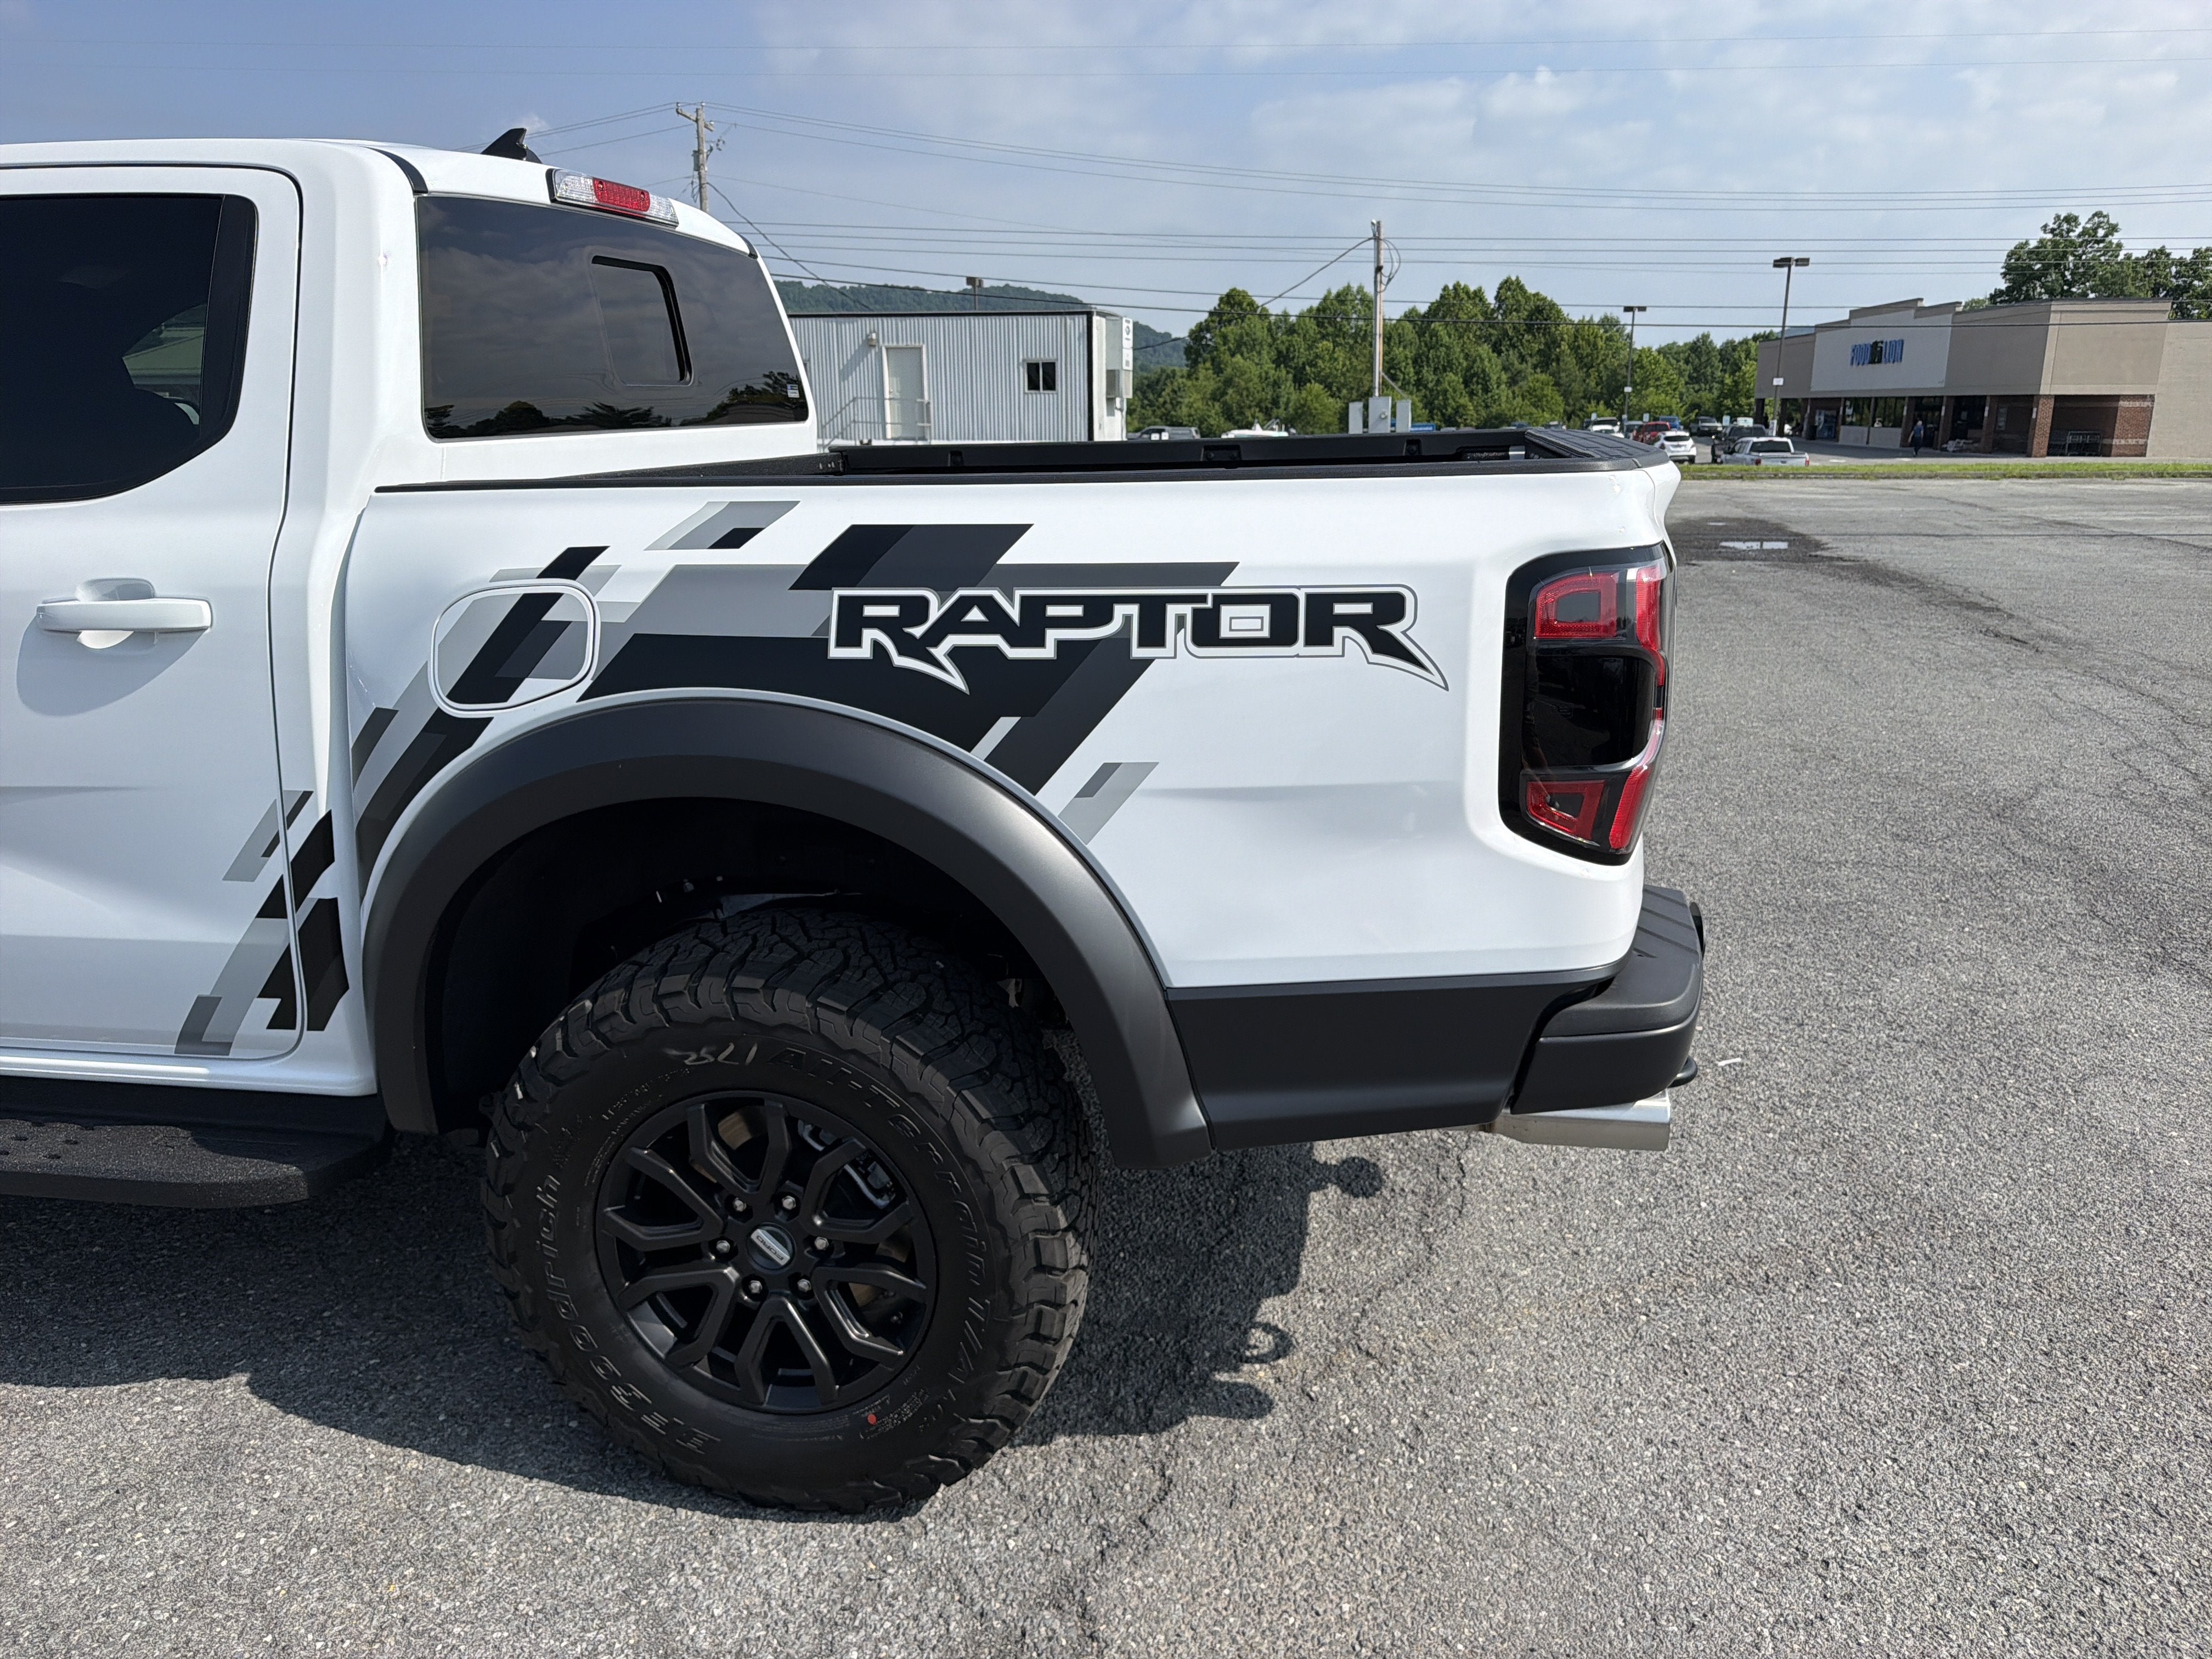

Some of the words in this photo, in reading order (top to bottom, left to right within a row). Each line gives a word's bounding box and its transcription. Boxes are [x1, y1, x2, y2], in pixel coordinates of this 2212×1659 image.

[1850, 343, 1873, 366] FOOD
[1882, 338, 1904, 364] LION
[828, 584, 1449, 695] RAPTOR
[756, 1235, 785, 1261] FORD
[535, 1174, 721, 1455] BFGoodrich
